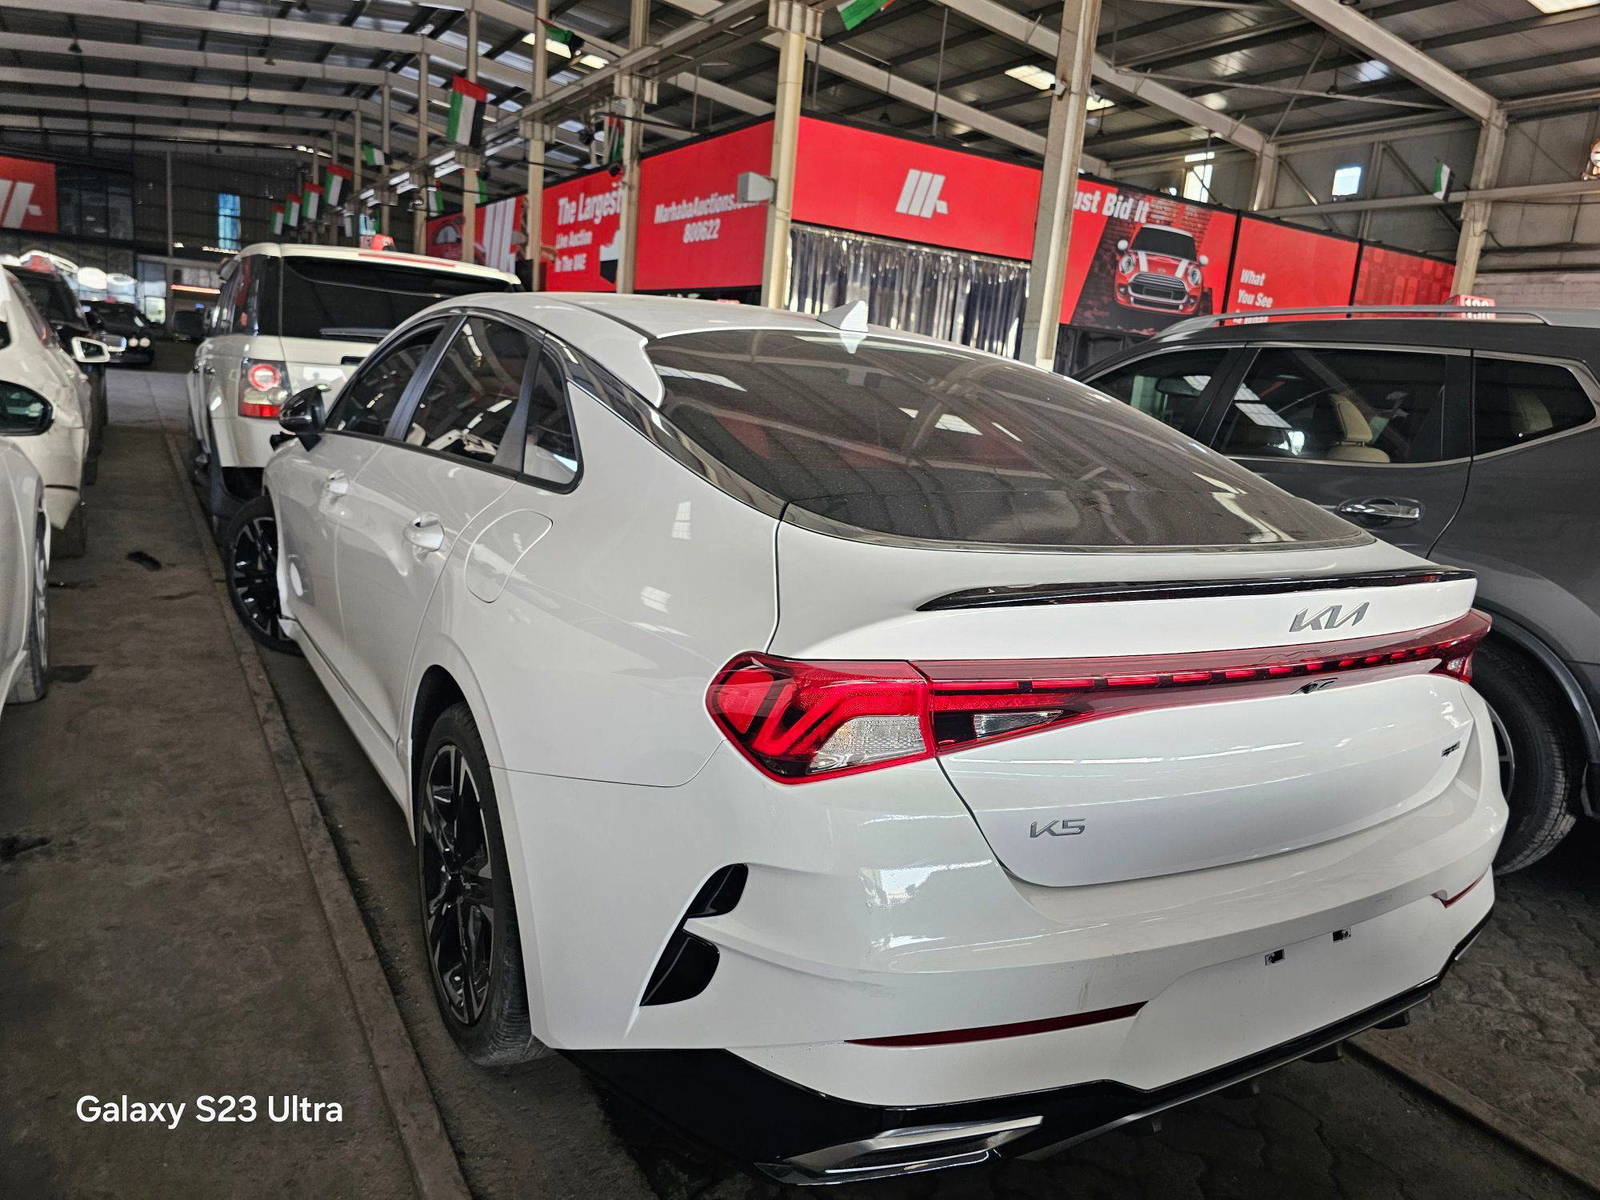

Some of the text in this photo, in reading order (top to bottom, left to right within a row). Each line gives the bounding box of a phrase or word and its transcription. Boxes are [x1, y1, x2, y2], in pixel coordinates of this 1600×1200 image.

[557, 187, 622, 226] The Largest
[1073, 190, 1150, 224] ust Bid It
[1240, 268, 1266, 287] What
[1238, 289, 1274, 309] You See
[1029, 818, 1086, 838] K5
